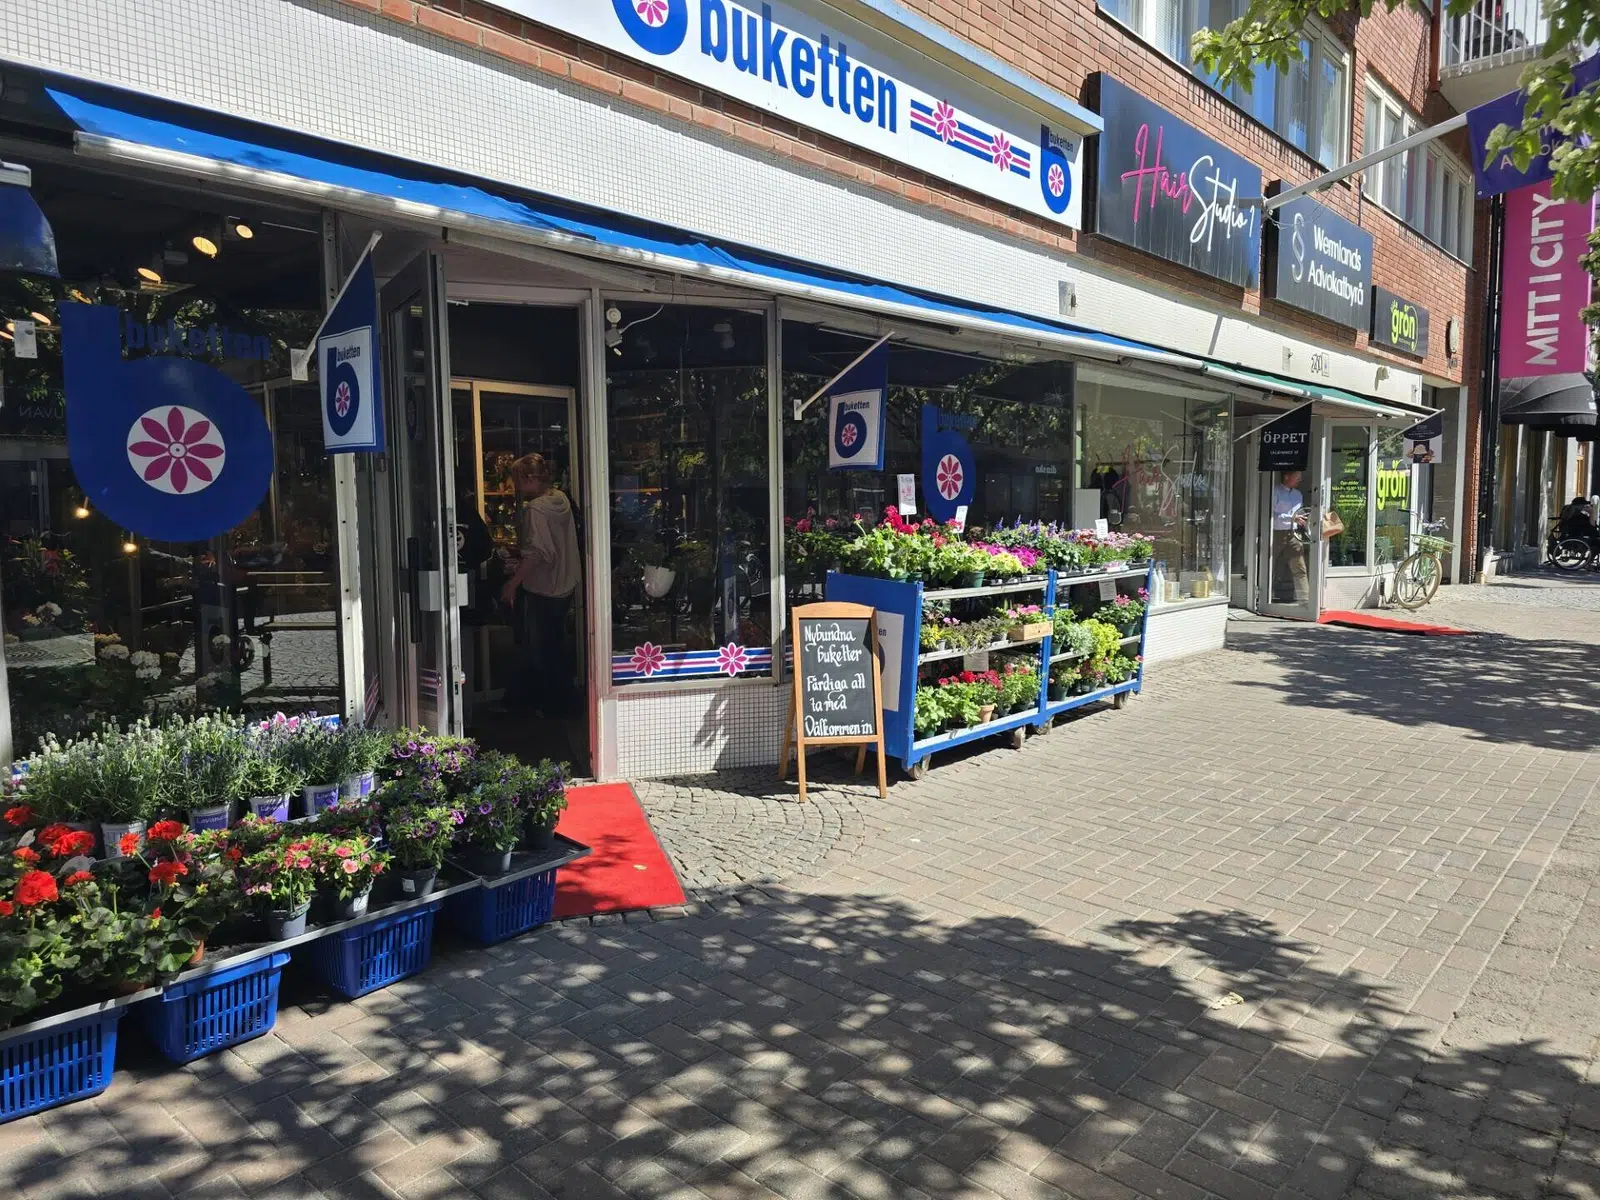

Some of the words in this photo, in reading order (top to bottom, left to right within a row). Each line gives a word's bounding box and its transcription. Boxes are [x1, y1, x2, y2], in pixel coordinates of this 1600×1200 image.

[700, 0, 897, 134] buketten
[1049, 131, 1074, 153] buketten
[1121, 123, 1194, 224] Hair
[1188, 155, 1249, 252] Studio
[1529, 193, 1566, 268] CITY
[1313, 224, 1362, 272] Wermlands
[1307, 260, 1364, 307] Advokatbyrå
[1528, 273, 1562, 285] I
[1524, 291, 1561, 366] MITT
[844, 400, 871, 412] buketten
[1263, 430, 1308, 444] ÖPPET
[804, 622, 857, 652] Nybundna
[816, 643, 862, 667] buketter
[806, 672, 848, 701] Färdiga
[809, 697, 823, 712] ta
[823, 693, 848, 712] med
[804, 715, 860, 737] Välkommen
[860, 720, 874, 735] in
